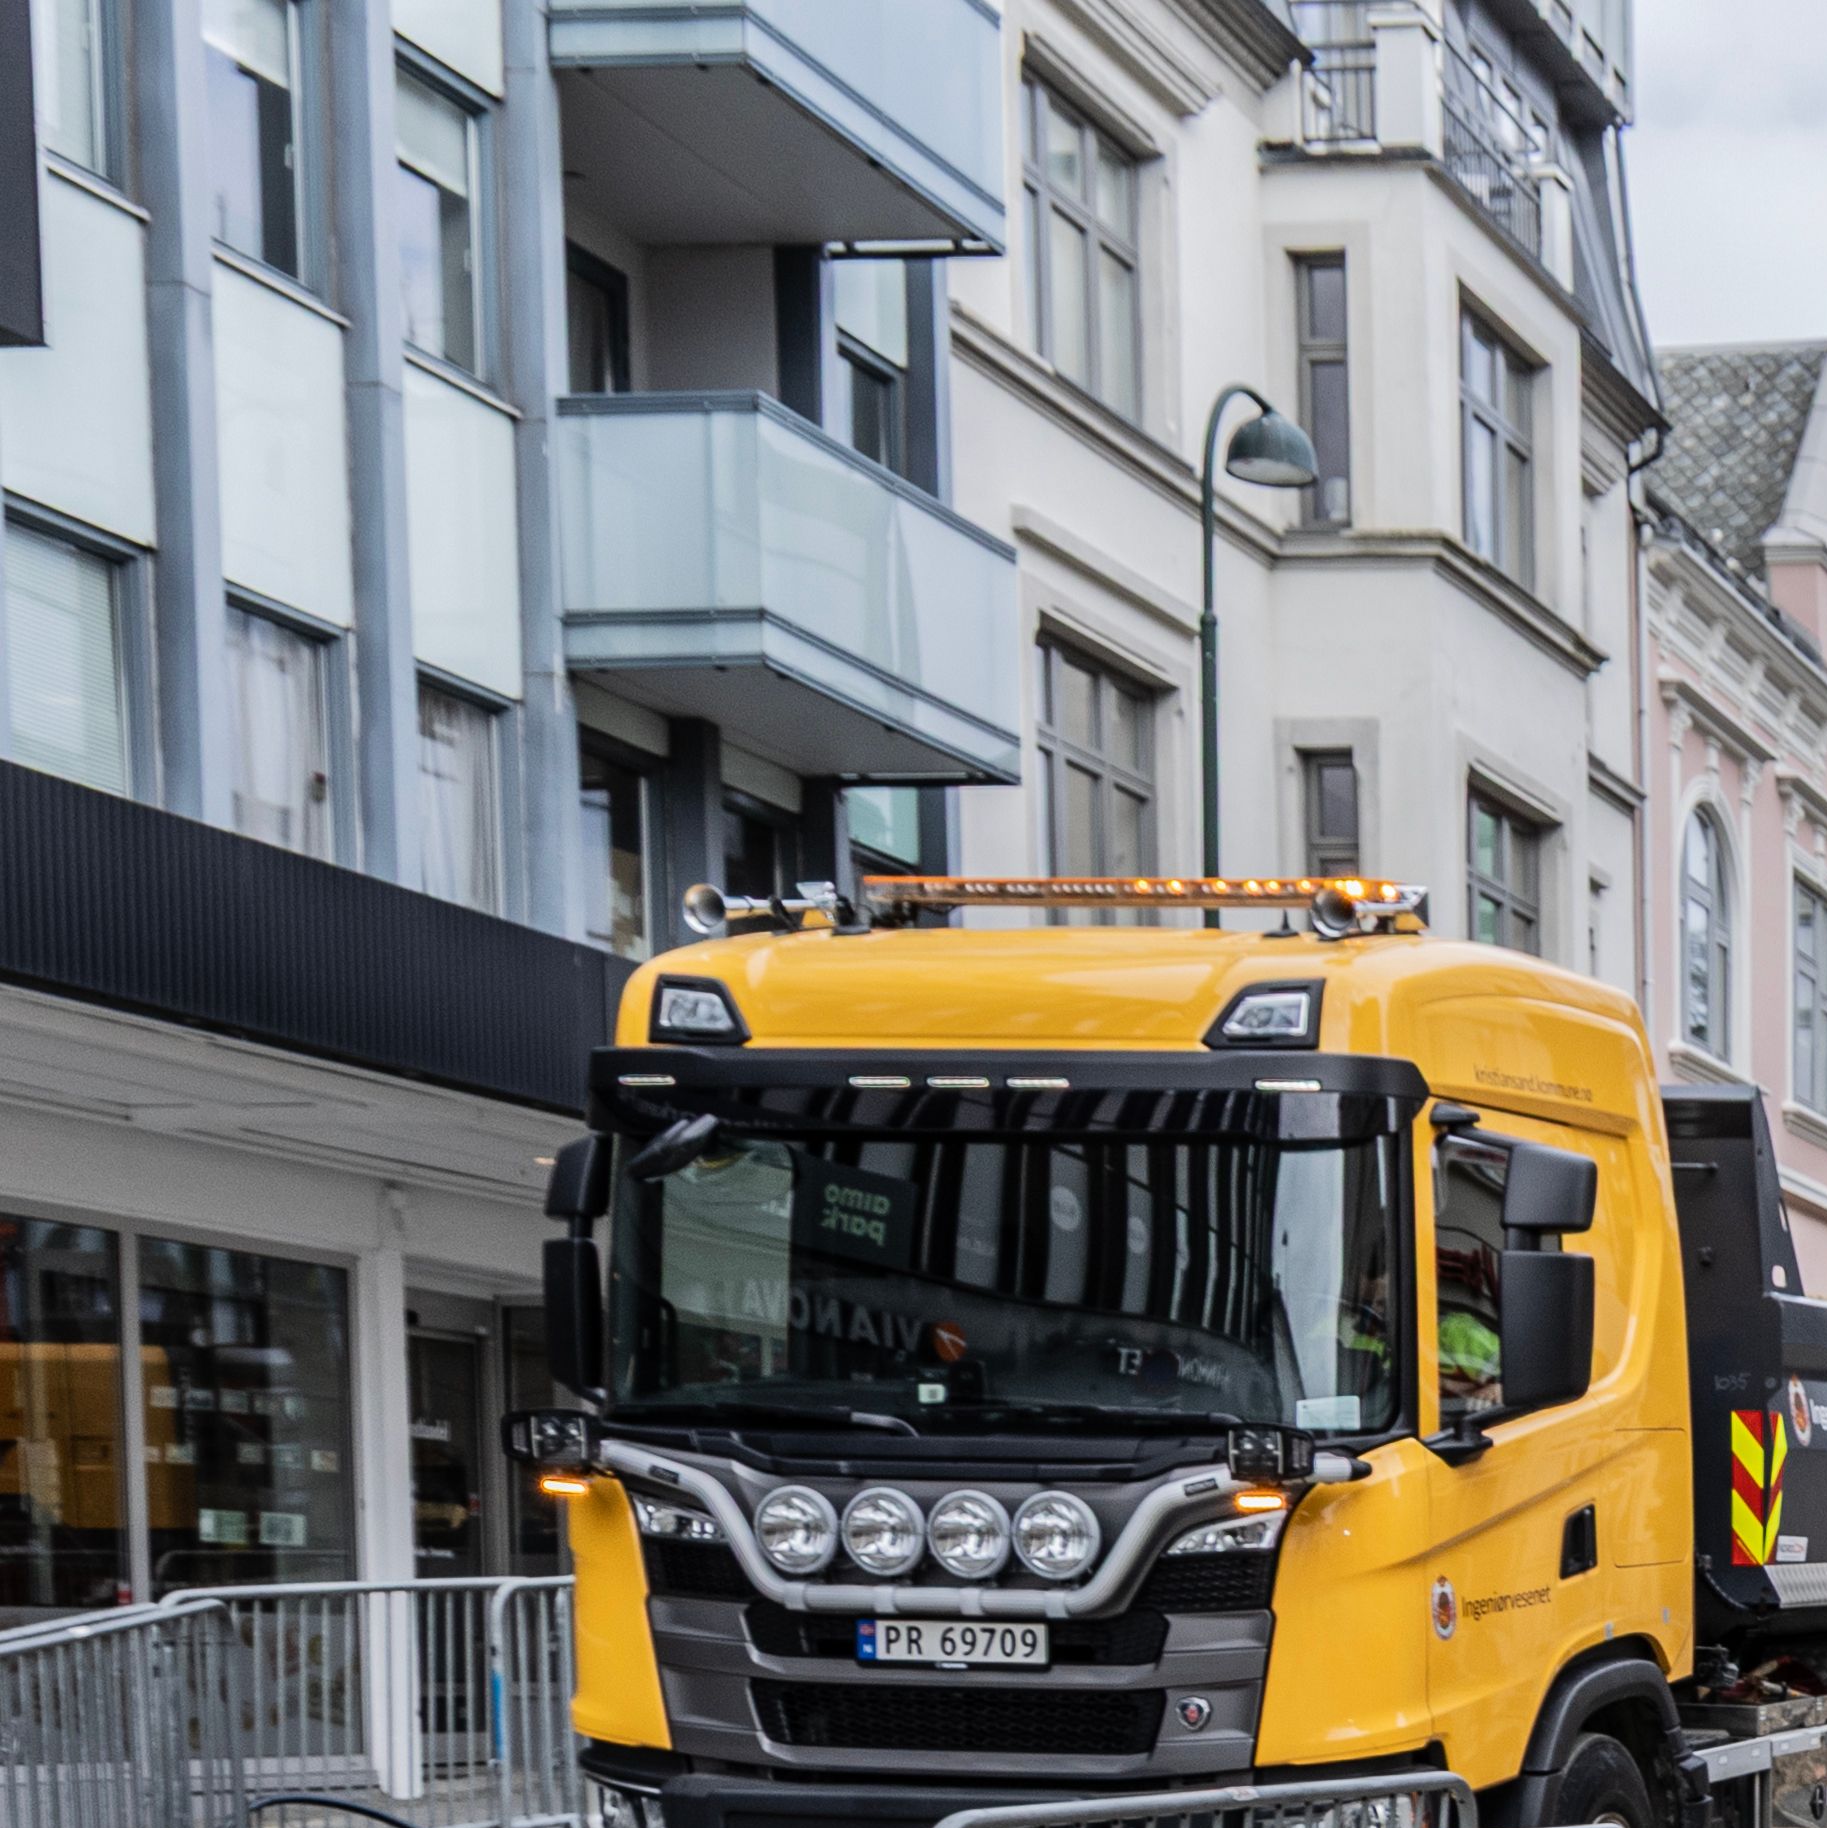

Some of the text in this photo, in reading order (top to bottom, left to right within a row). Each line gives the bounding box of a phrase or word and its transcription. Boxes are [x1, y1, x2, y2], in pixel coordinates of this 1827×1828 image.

[1461, 1585, 1552, 1621] Ingeniørvesenet
[884, 1625, 1038, 1658] PR 69709
